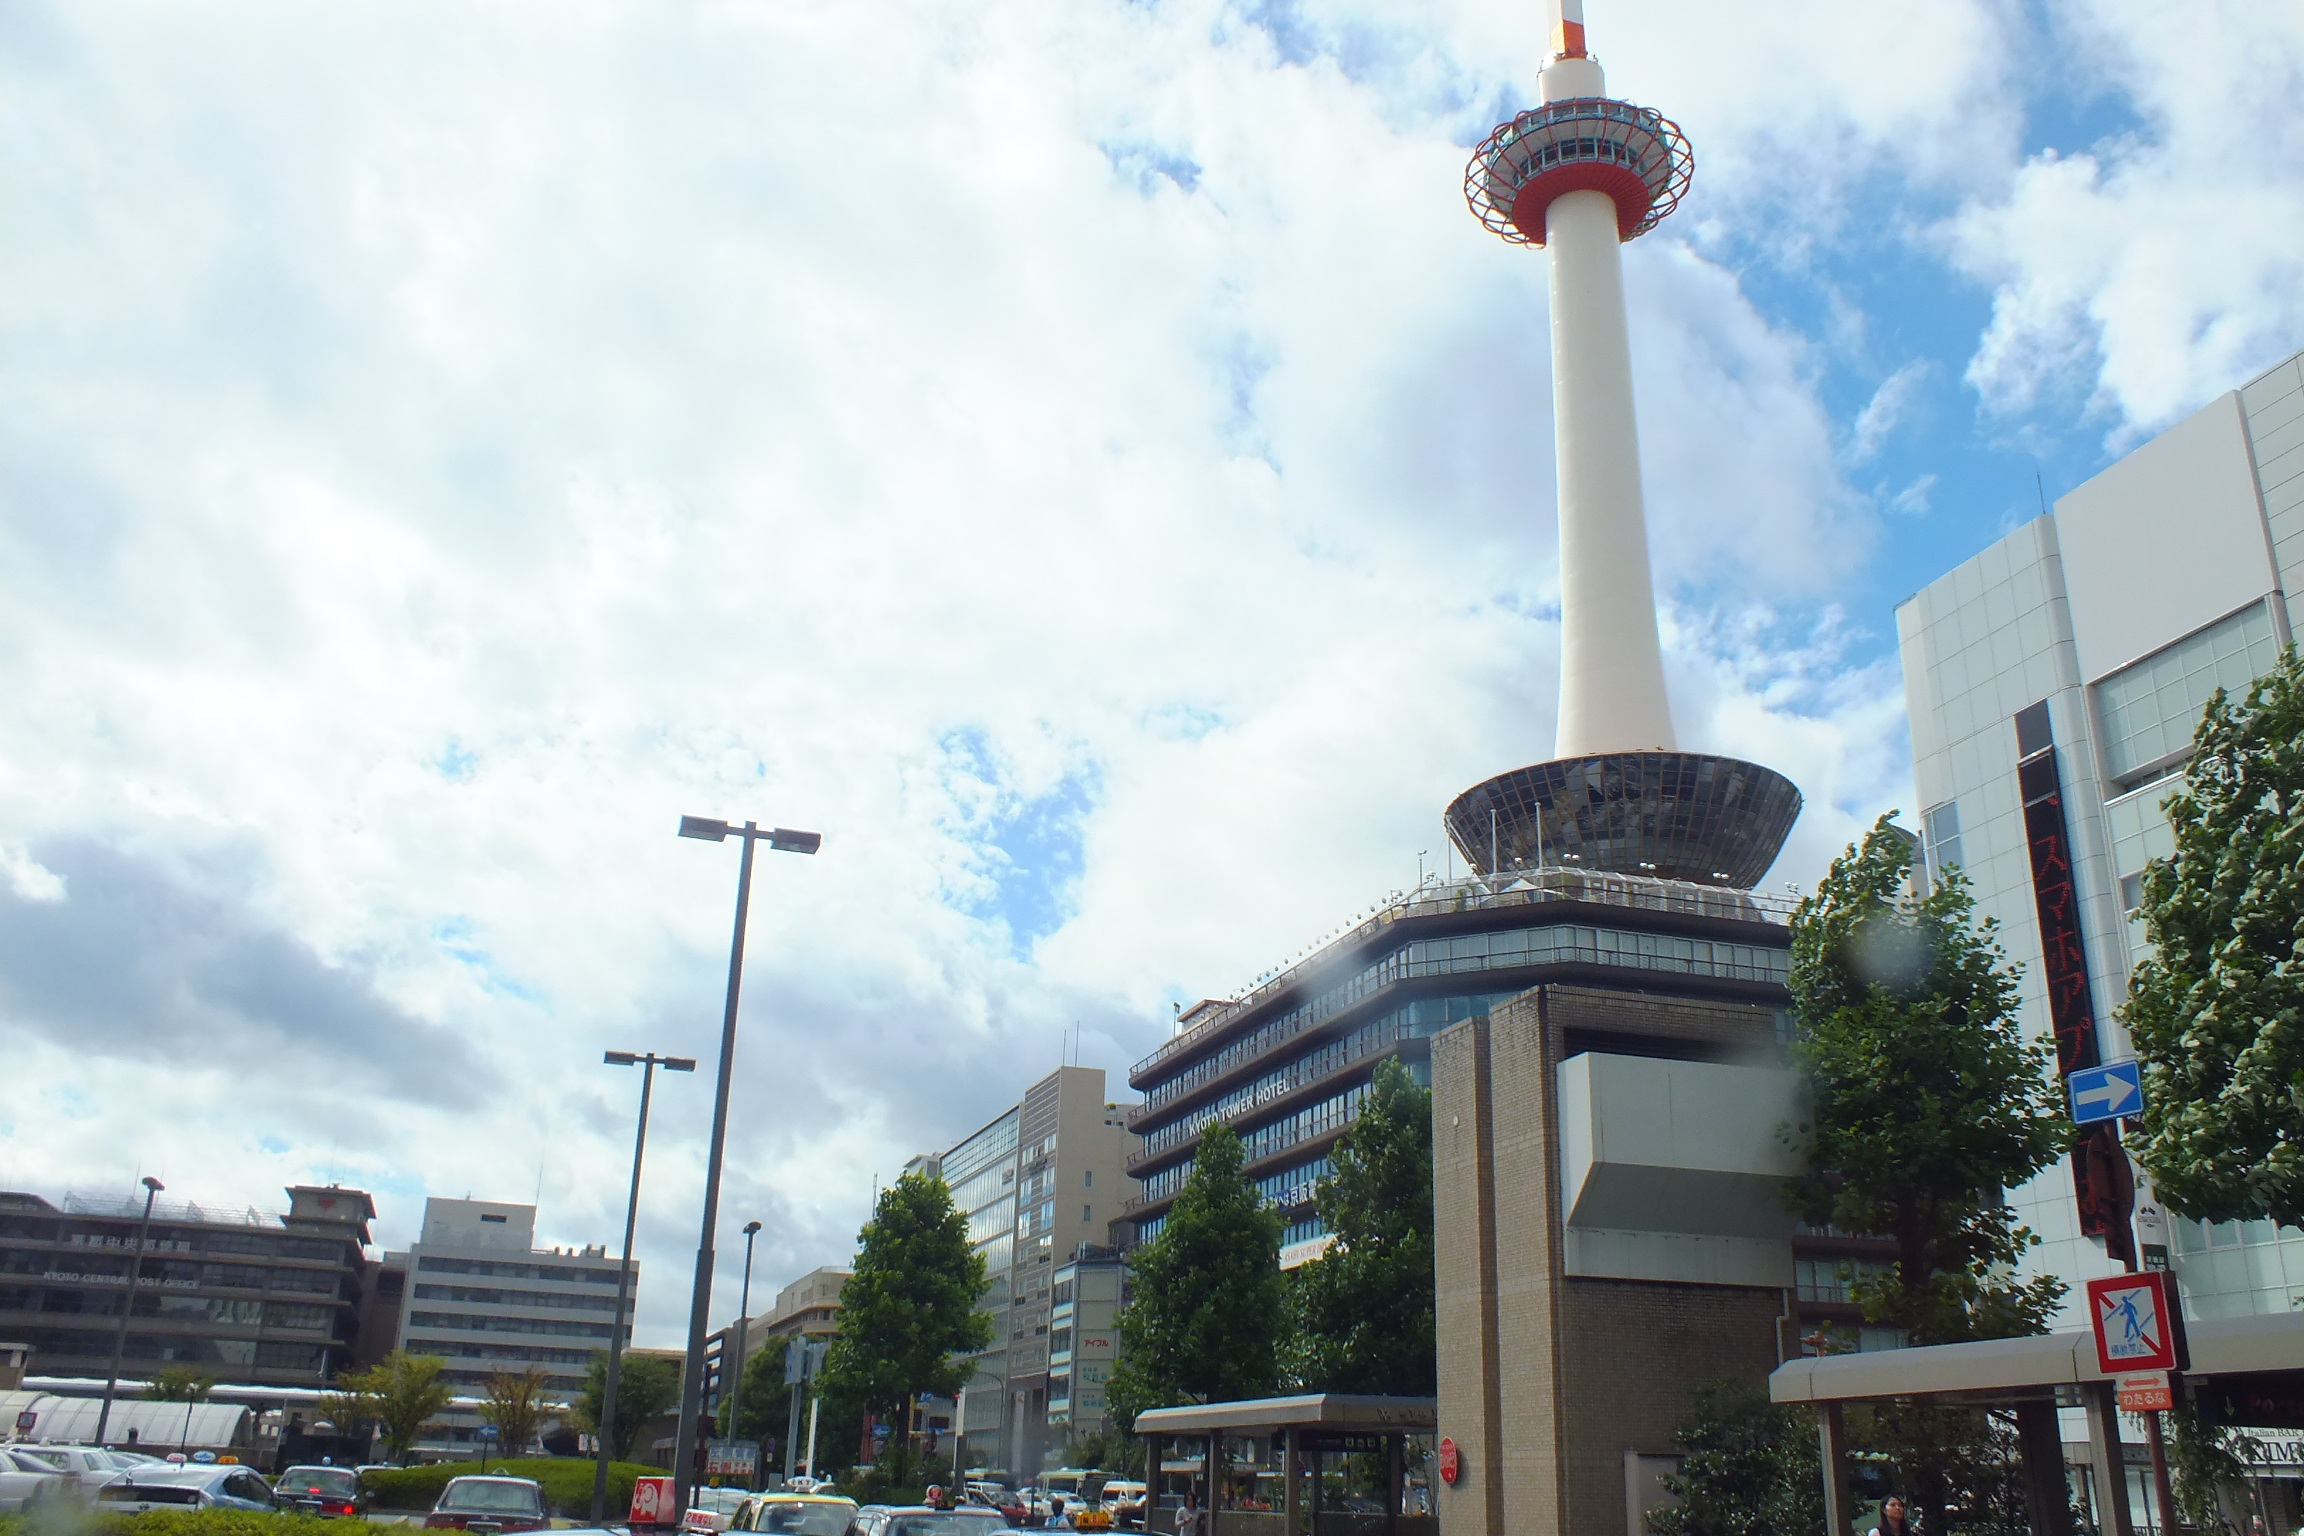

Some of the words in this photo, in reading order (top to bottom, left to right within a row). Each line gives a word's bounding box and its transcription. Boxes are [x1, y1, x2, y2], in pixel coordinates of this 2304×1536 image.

[1189, 1111, 1219, 1137] KYOTO
[1219, 1094, 1254, 1121] TOWER
[1256, 1078, 1290, 1105] HOTEL
[43, 1271, 80, 1282] KYOTO
[164, 1279, 200, 1289] OFFICE
[2123, 1391, 2166, 1406] わたるな
